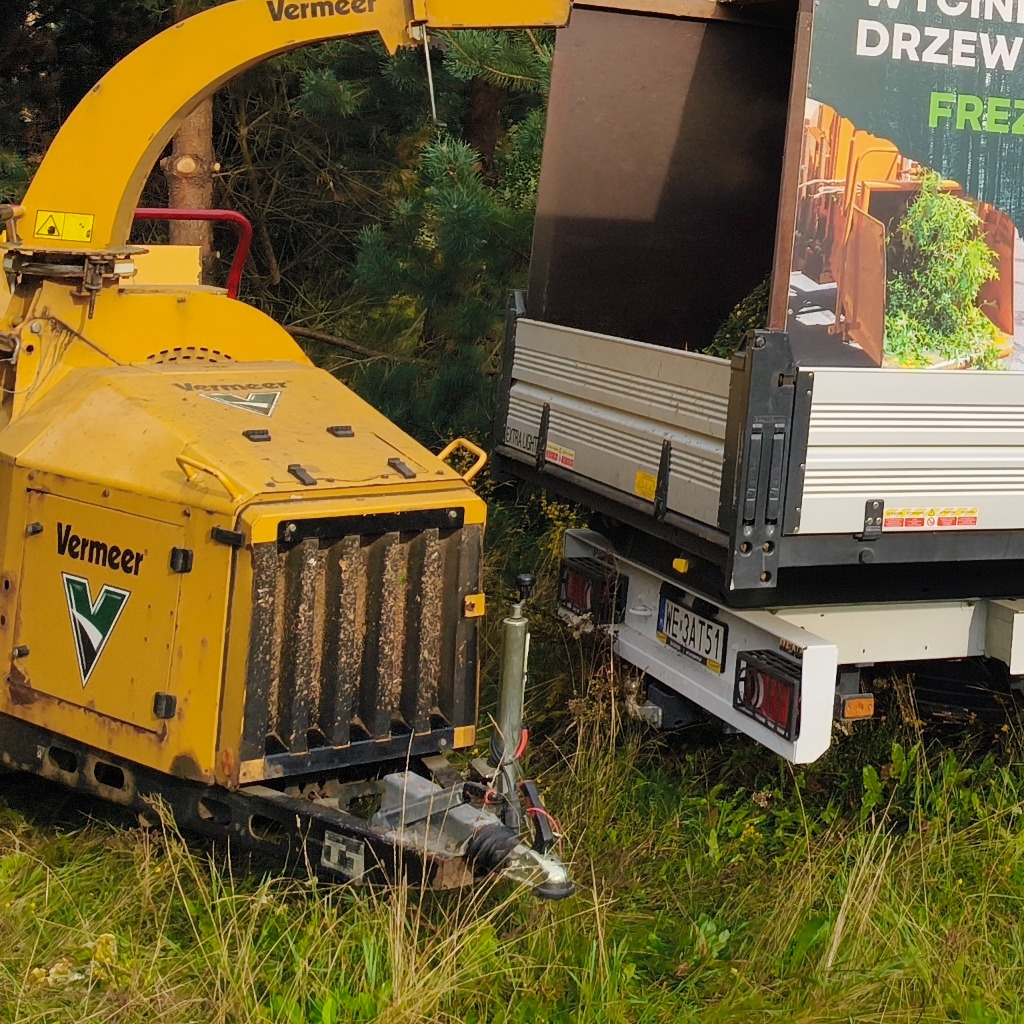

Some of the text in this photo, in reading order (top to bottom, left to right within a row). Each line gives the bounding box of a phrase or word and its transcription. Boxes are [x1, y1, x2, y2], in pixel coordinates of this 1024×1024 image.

[856, 18, 1024, 72] DRZEW
[172, 381, 288, 391] Vermeer
[57, 522, 143, 576] Vermeer
[665, 602, 680, 638] WE
[682, 613, 720, 660] 3AT51
